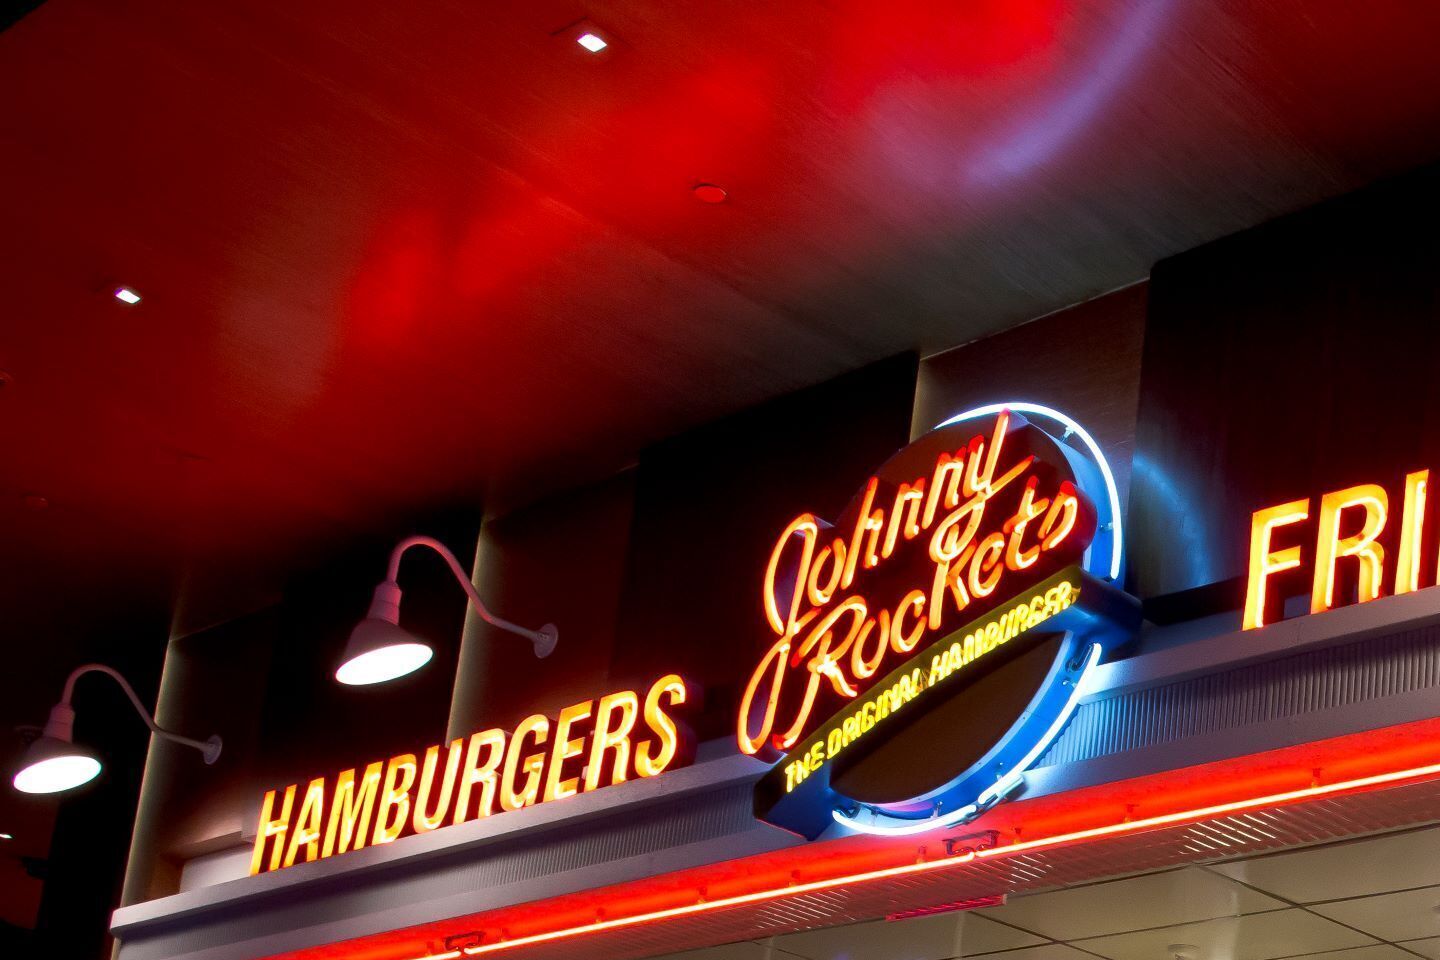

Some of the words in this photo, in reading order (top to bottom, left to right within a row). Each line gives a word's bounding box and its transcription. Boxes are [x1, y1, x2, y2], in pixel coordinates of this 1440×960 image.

[737, 409, 1034, 755] Johnny
[772, 476, 1079, 750] Rockets
[784, 729, 826, 793] THE
[827, 667, 921, 761] ORIGINAL
[927, 580, 1080, 687] HAMBURGER
[249, 673, 687, 877] HAMBURGERS
